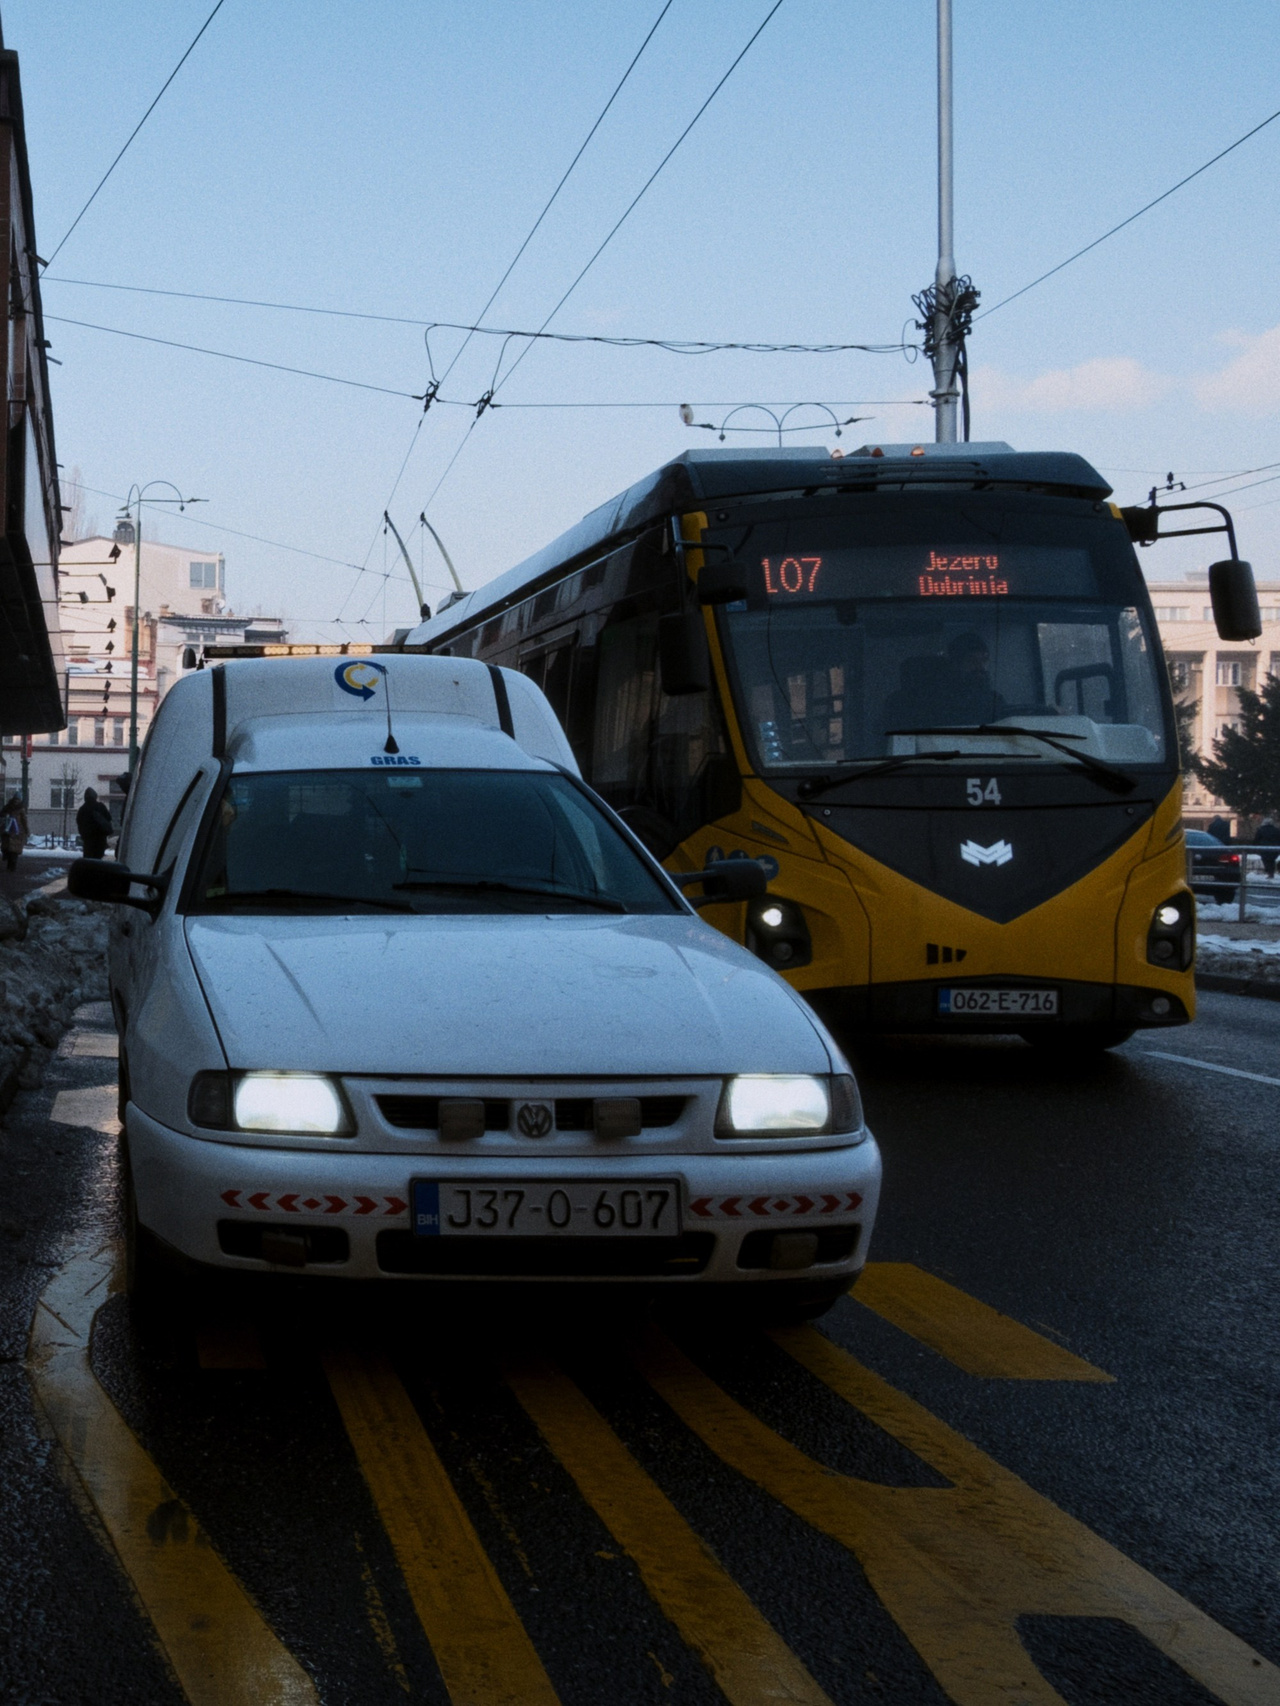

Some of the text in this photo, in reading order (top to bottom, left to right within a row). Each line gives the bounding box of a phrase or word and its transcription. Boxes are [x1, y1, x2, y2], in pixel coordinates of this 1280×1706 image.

[761, 558, 821, 592] 107
[370, 756, 421, 766] GRAS
[966, 777, 1002, 806] 54
[418, 1214, 439, 1226] BIH
